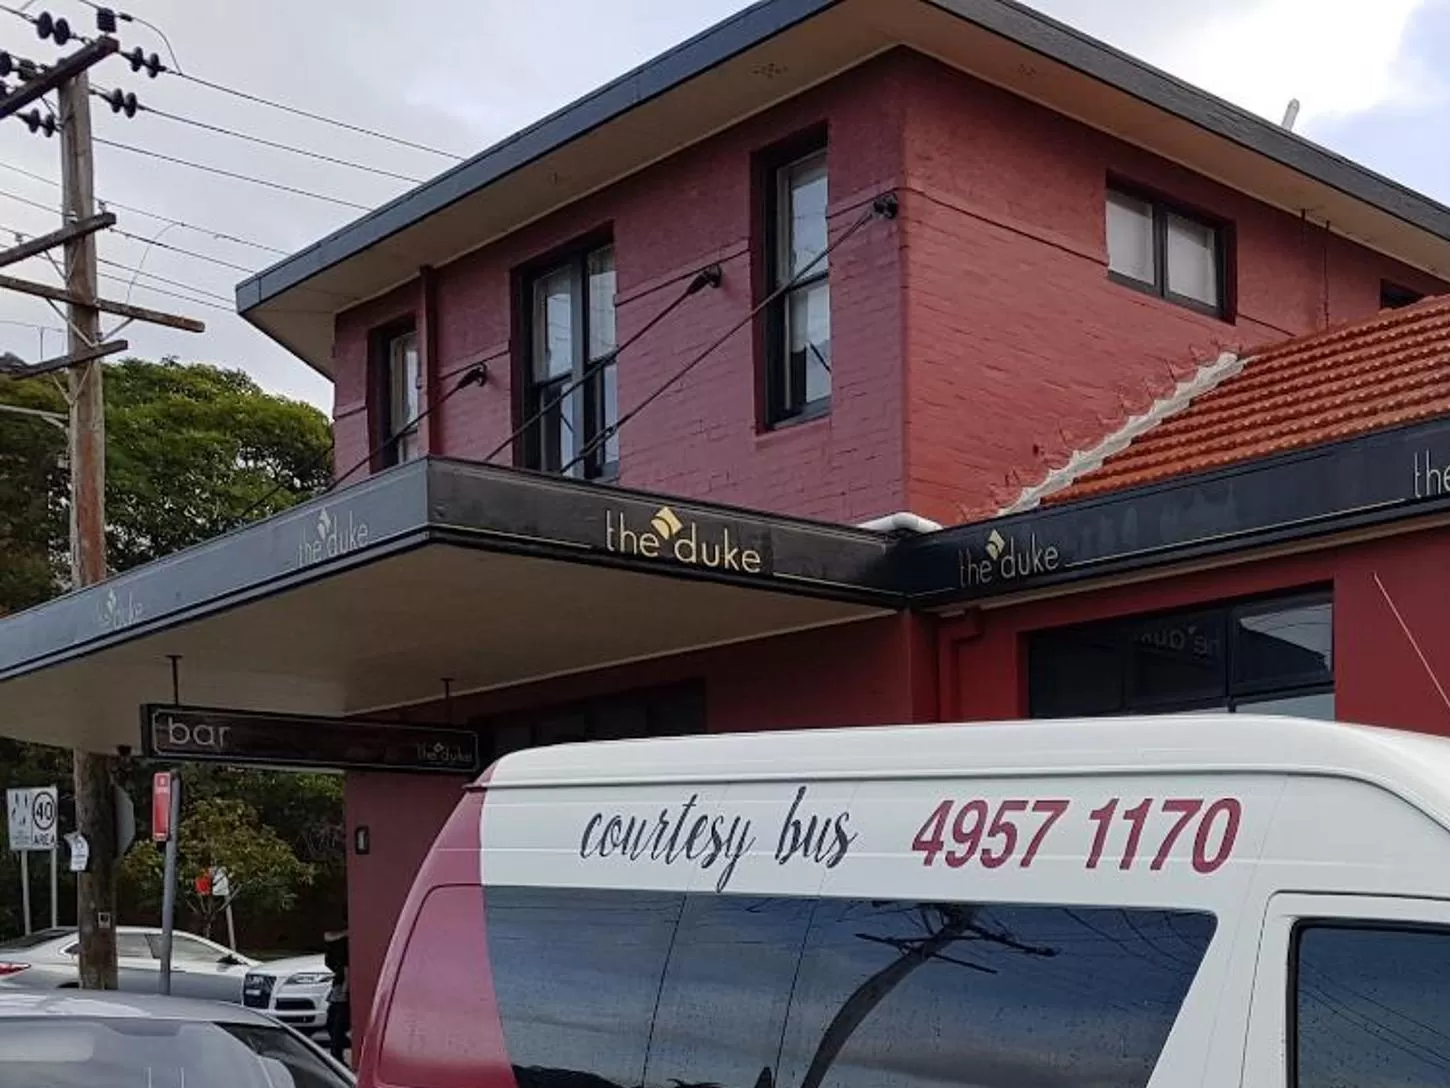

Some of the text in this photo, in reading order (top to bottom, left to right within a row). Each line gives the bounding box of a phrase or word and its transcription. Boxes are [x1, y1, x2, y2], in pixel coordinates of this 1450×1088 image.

[326, 509, 369, 558] duke
[605, 509, 761, 574] the duke
[958, 531, 1059, 589] the duke
[167, 715, 232, 749] bar
[34, 801, 54, 821] 40
[578, 785, 1244, 893] courtesy bus 4957 1170
